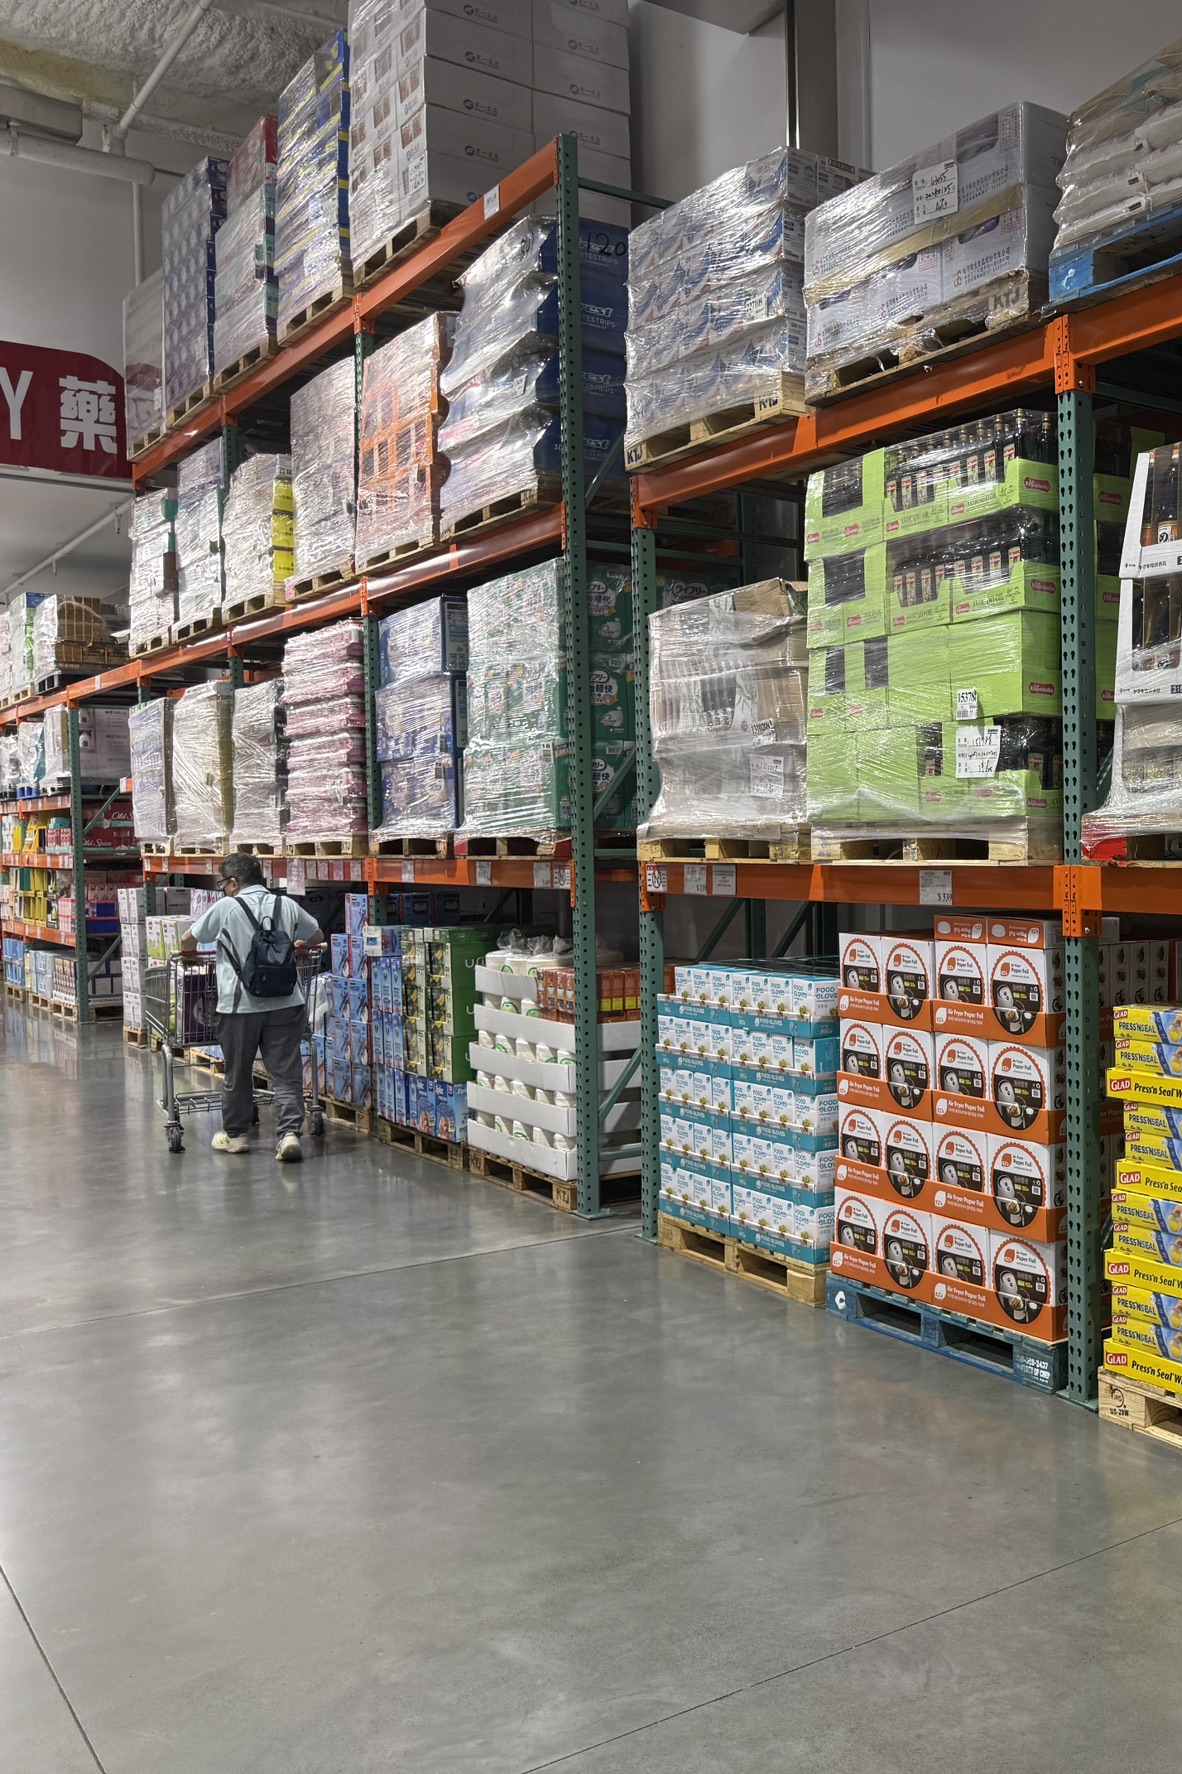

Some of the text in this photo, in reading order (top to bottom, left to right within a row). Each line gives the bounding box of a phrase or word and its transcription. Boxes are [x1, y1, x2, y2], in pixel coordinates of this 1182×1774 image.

[58, 374, 118, 454] 藥
[1114, 1010, 1128, 1019] GLAD
[1110, 1079, 1132, 1092] GLAD
[1133, 1082, 1159, 1096] Press'n
